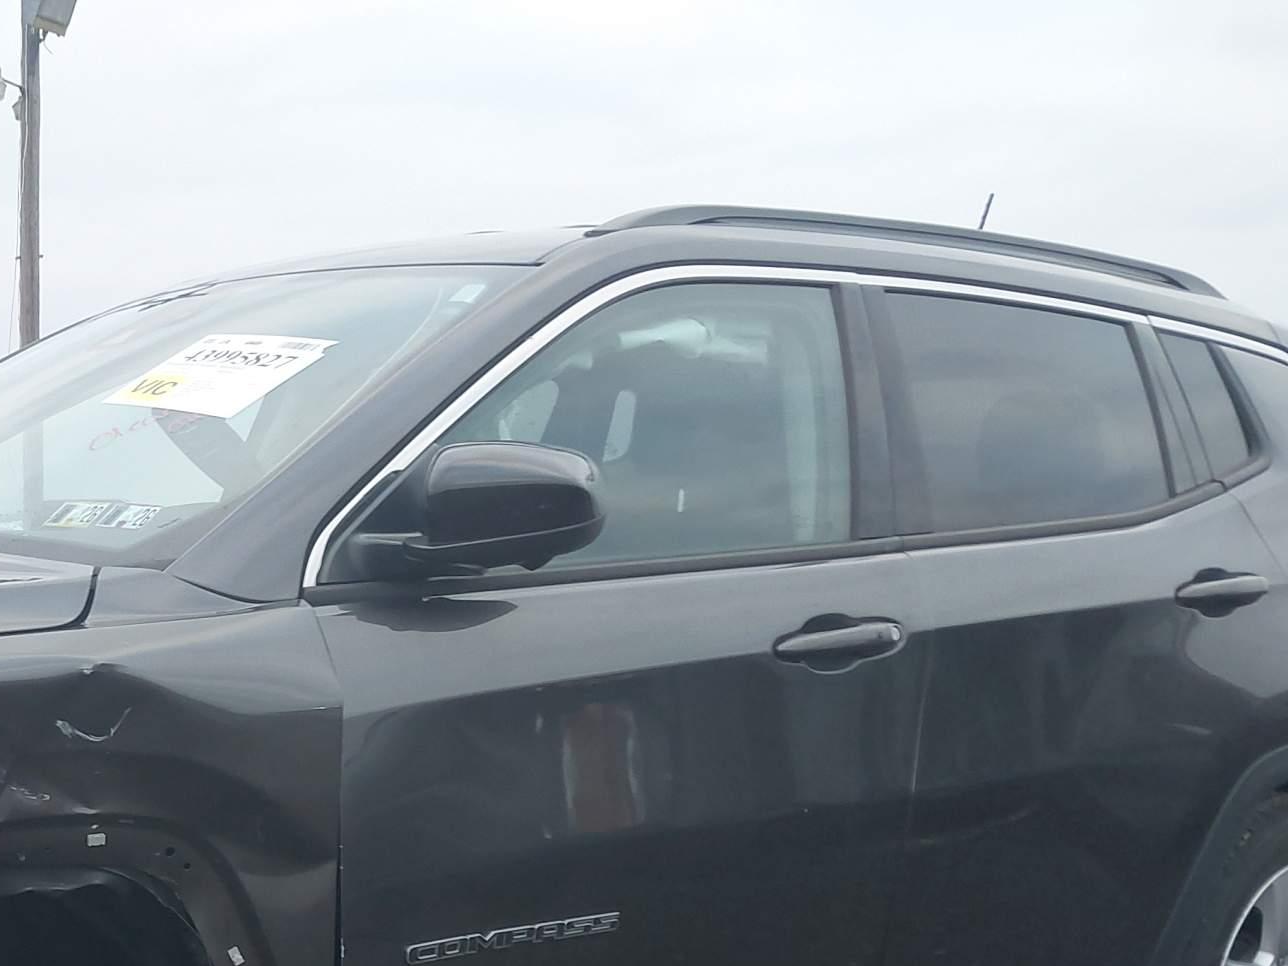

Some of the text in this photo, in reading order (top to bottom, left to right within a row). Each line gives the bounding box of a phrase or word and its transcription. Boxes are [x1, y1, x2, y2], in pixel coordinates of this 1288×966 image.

[184, 348, 300, 370] 43995827
[131, 379, 178, 396] VIC
[406, 911, 621, 965] COMPASS
